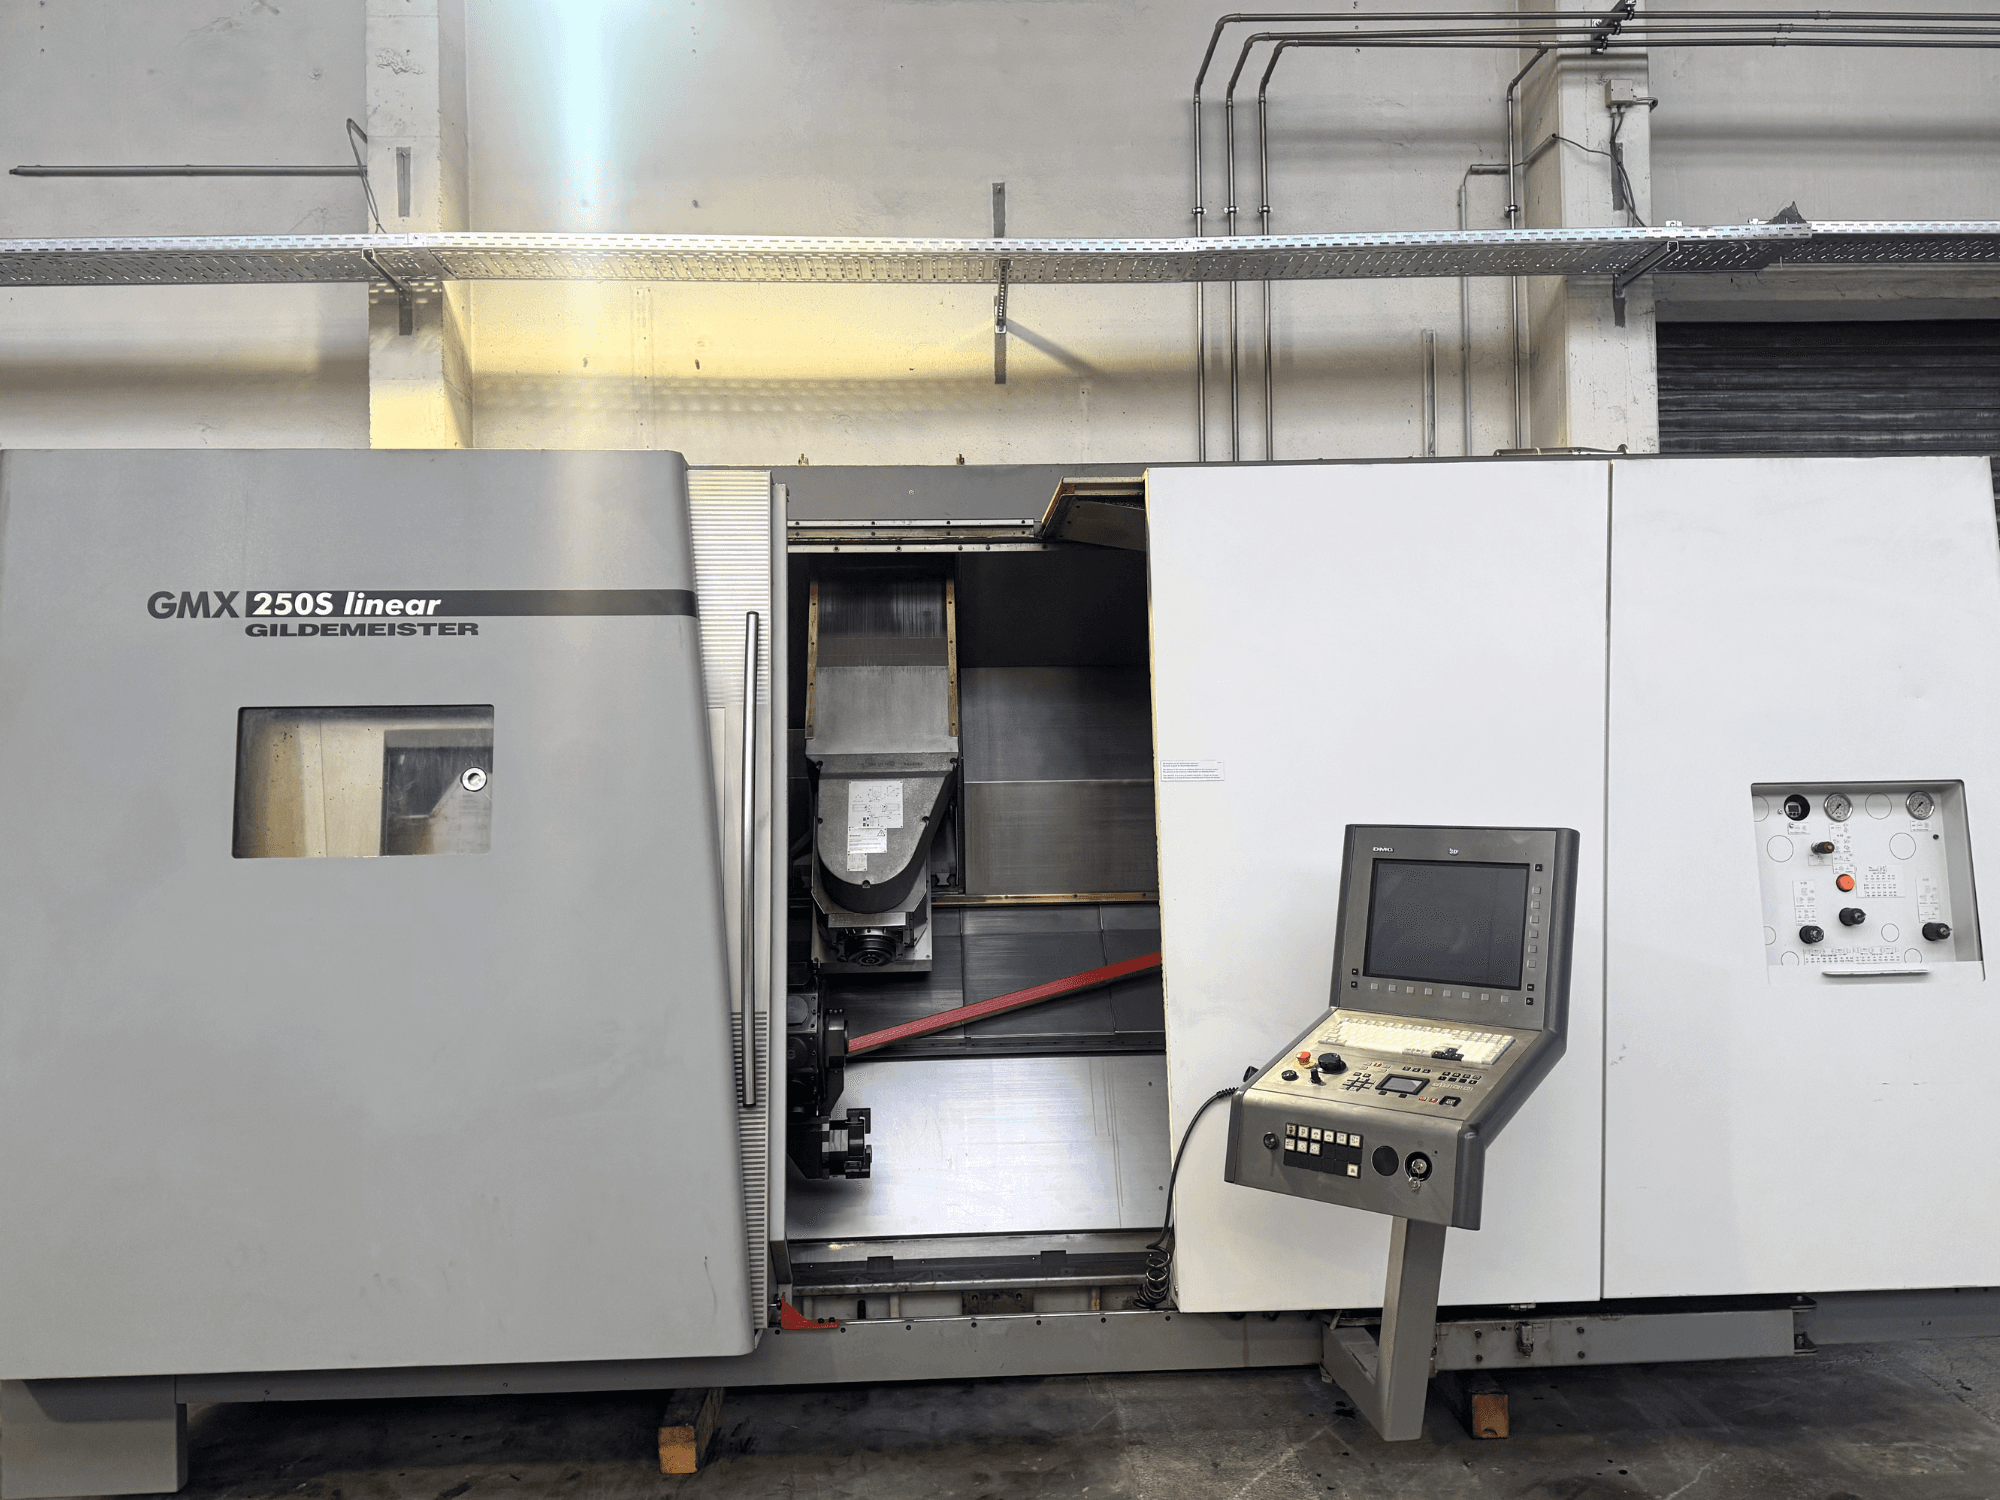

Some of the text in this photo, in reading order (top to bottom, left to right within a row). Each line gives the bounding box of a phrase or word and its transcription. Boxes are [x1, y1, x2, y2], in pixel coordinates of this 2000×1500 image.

[147, 591, 442, 619] GMX 250S linear
[245, 622, 479, 637] GILDEMEISTER
